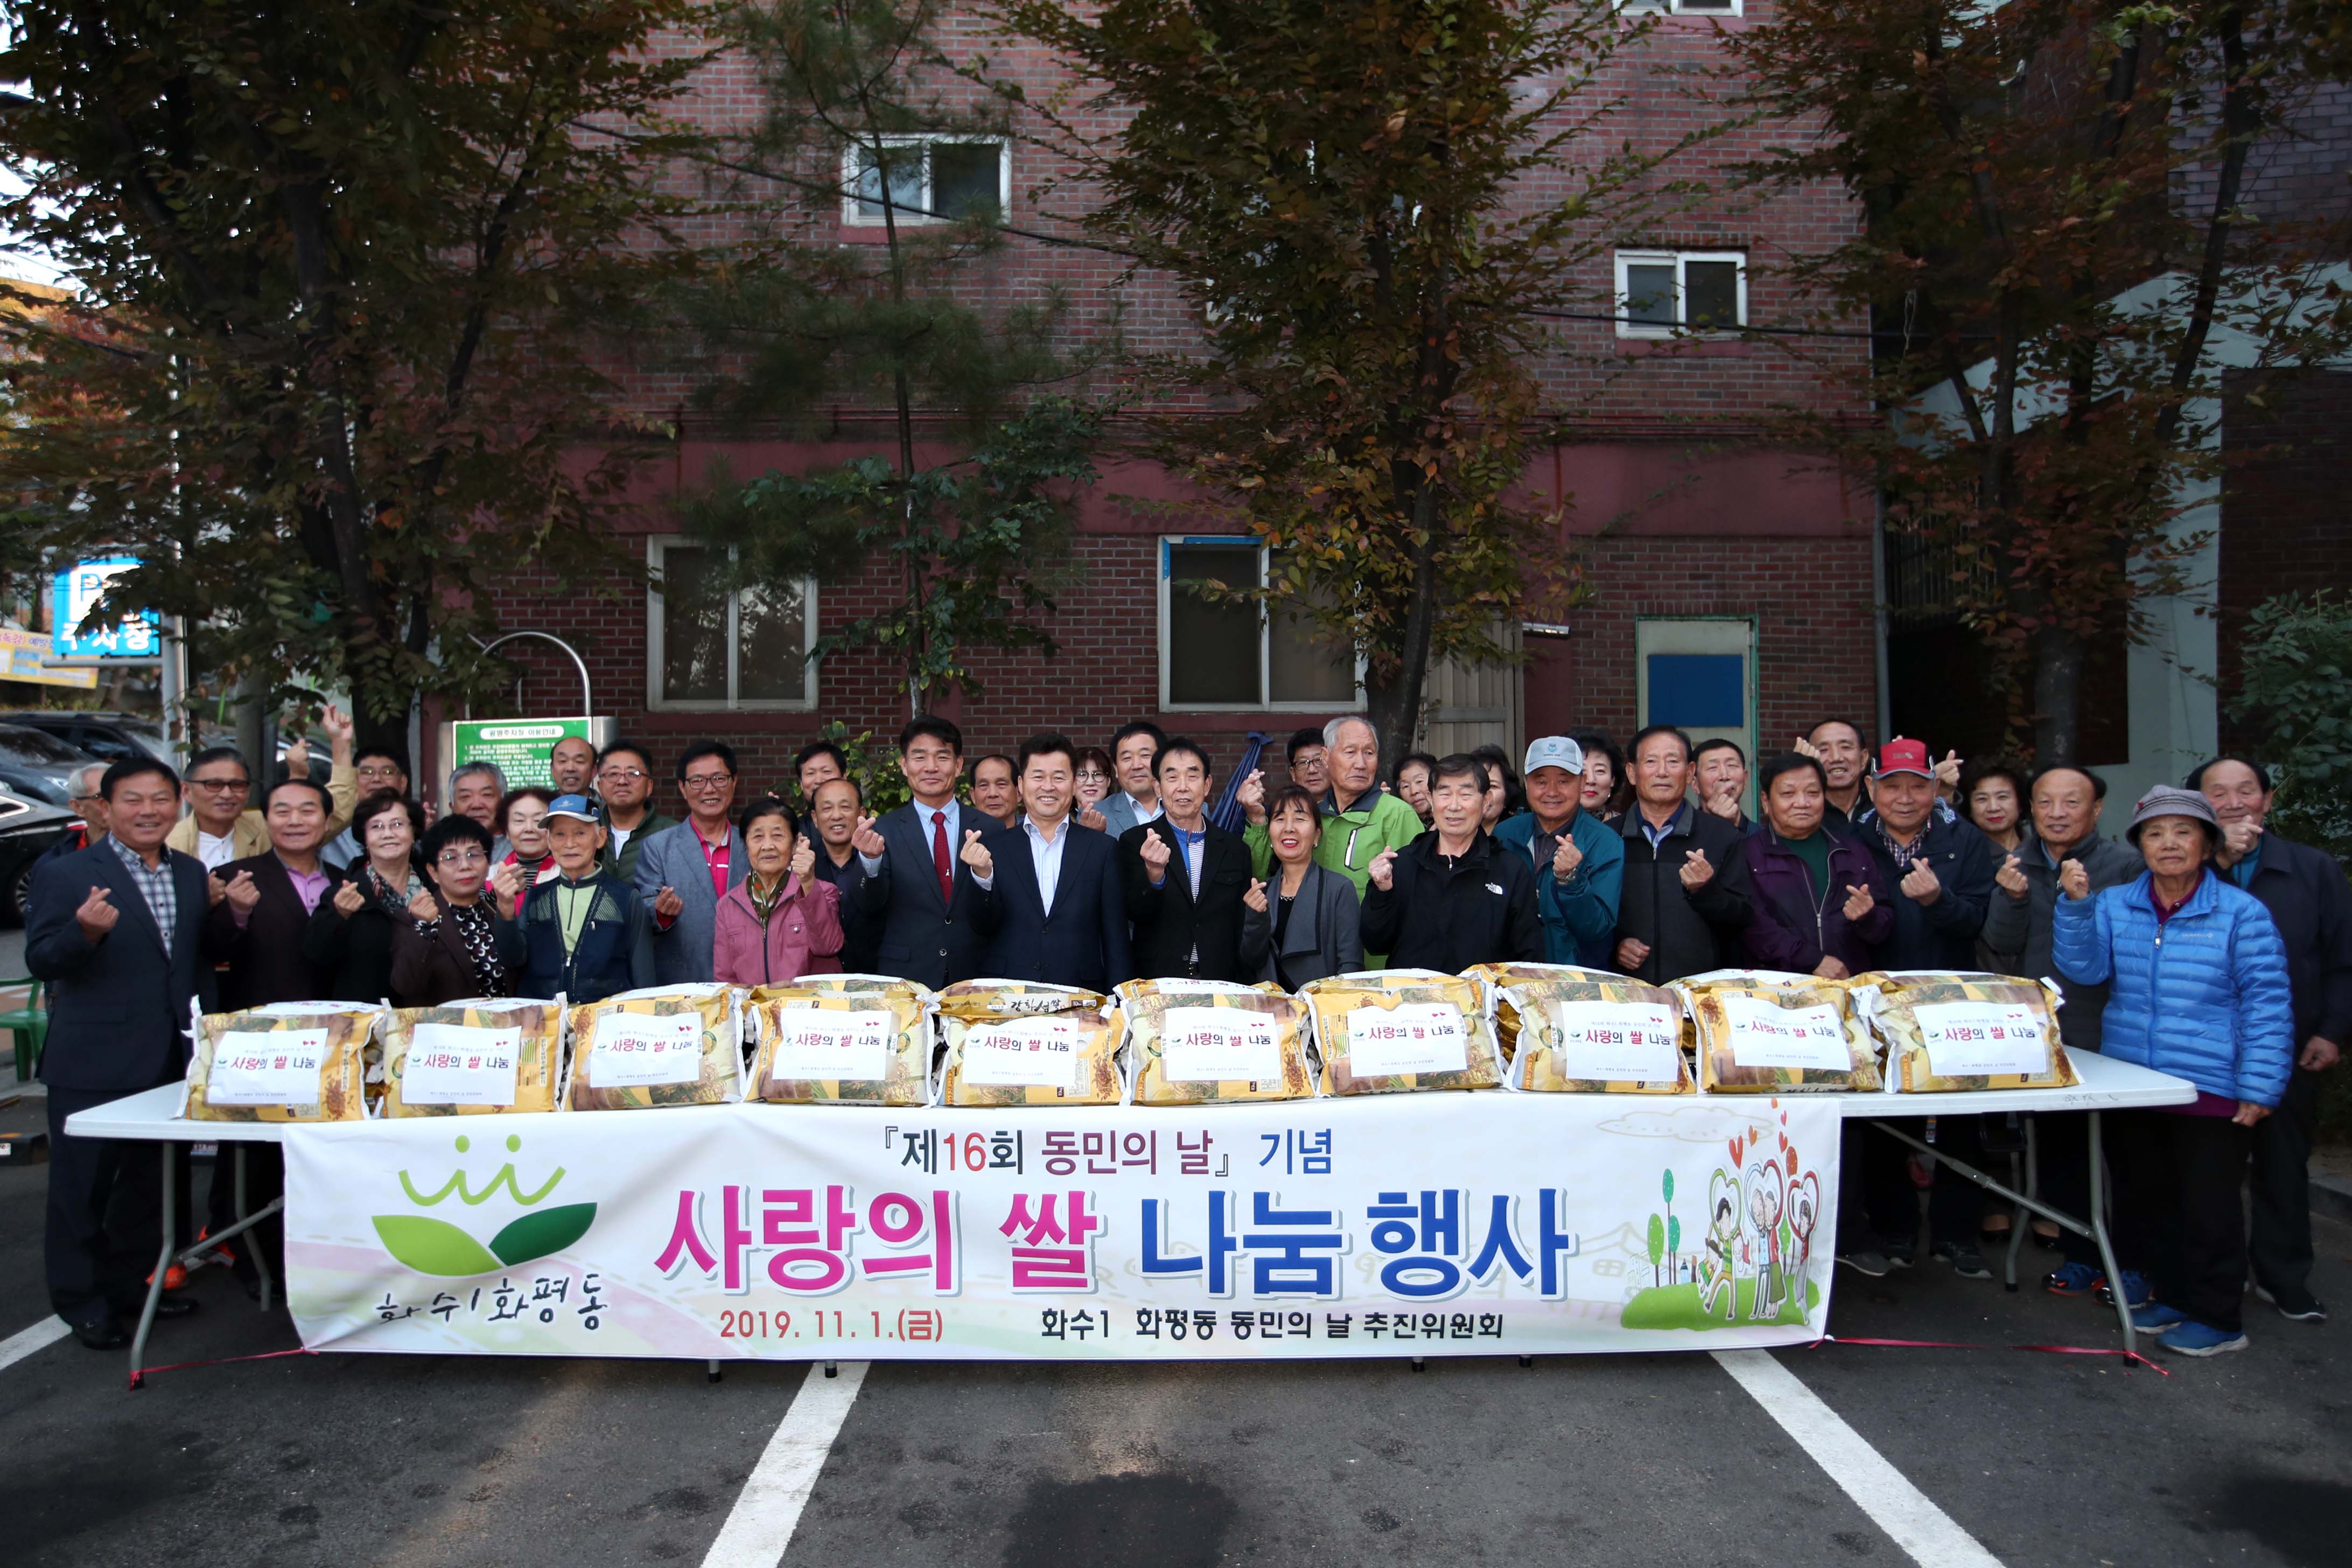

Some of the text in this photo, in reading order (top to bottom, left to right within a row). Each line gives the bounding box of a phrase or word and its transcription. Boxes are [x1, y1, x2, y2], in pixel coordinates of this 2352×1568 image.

[81, 573, 101, 601] P
[1369, 1025, 1454, 1040] 사랑의 쌀 나눔
[1751, 1020, 1836, 1038] 사랑의 쌀 나눔
[1945, 1026, 2035, 1041] 사랑의 쌀 나눔
[796, 1033, 880, 1047] 사랑의 쌀 나눔
[984, 1036, 1070, 1052] 사랑의 쌀 나눔
[1186, 1033, 1271, 1047] 사랑의 쌀 나눔
[1585, 1029, 1671, 1046] 사랑의 쌀 나눔
[611, 1039, 647, 1052] 사랑의
[654, 1041, 666, 1053] 쌀
[231, 1056, 316, 1070] 사랑의 쌀 나눔
[424, 1054, 509, 1069] 사랑의 쌀 나눔
[885, 1126, 1332, 1177] 『제16회 동민의 날』 기념
[654, 1185, 1569, 1296] 사랑의 쌀 나눔 행사
[1042, 1307, 1503, 1341] 화수1 화평동 동민의 날 추진위원회
